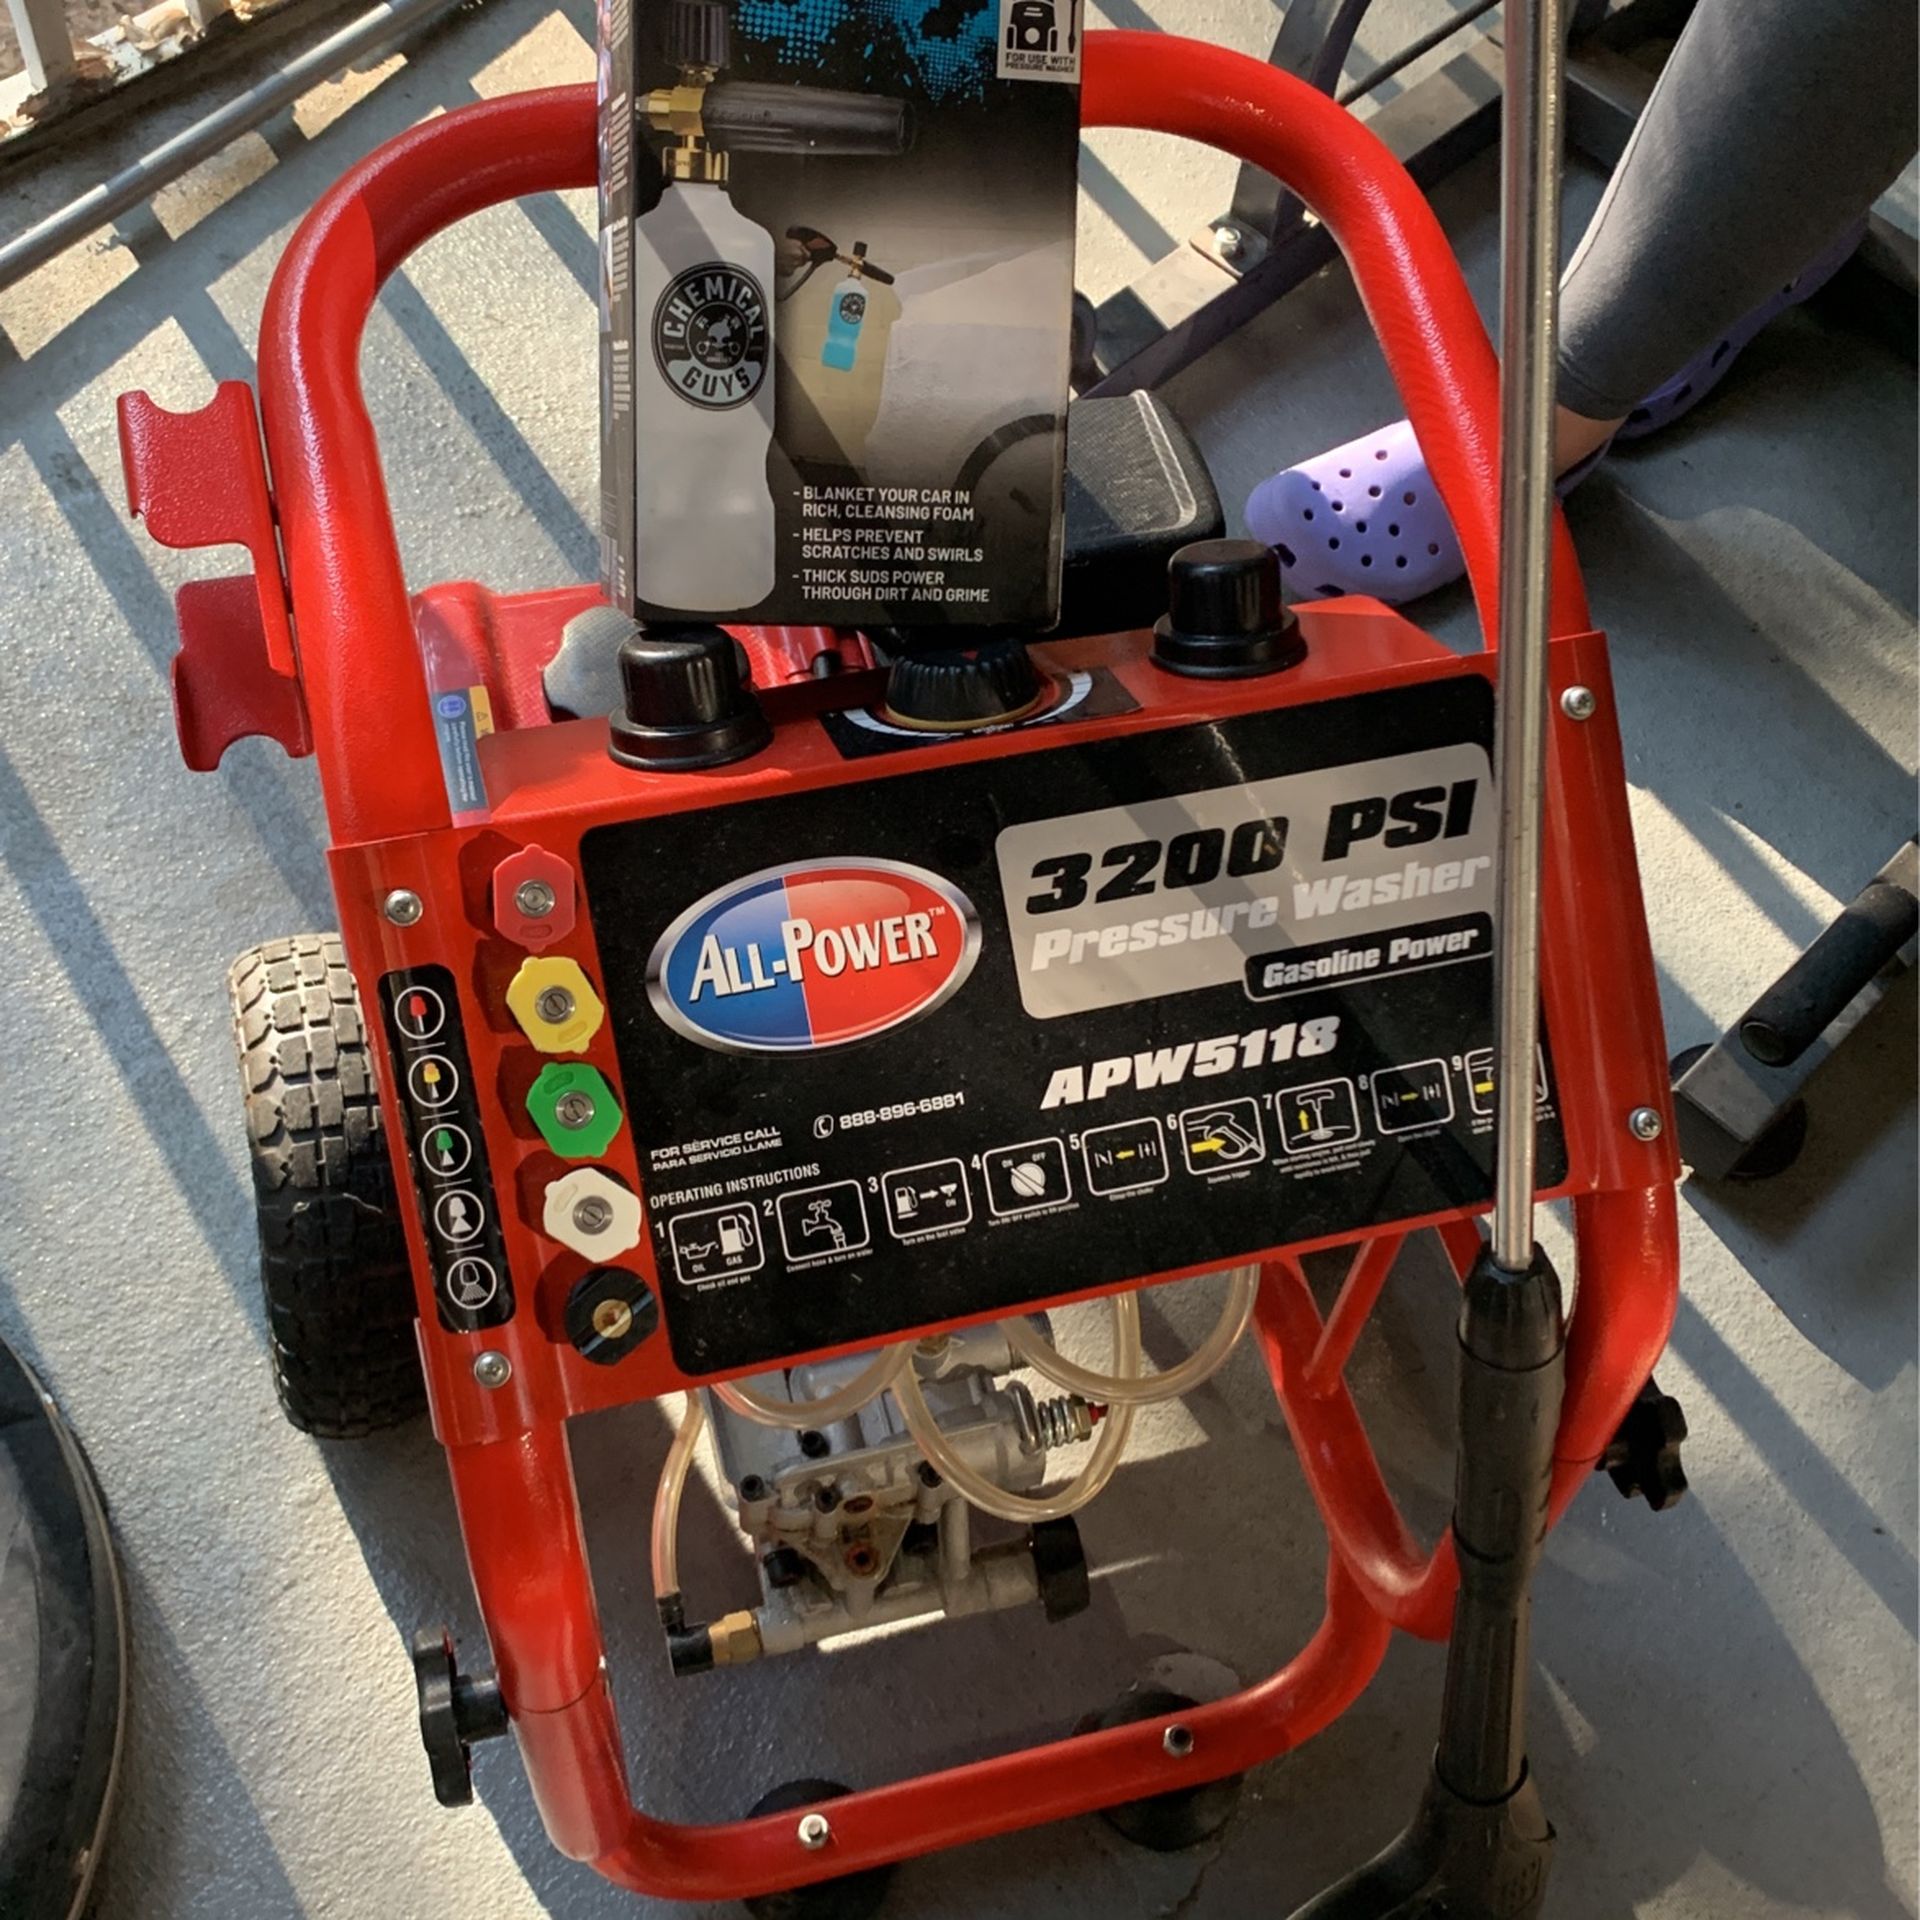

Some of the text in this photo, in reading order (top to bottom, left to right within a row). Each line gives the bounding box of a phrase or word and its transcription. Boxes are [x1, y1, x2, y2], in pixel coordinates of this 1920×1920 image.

[1006, 52, 1076, 65] FOR USE WITH
[663, 276, 763, 339] CHEMICAL
[682, 366, 750, 397] GUYS
[803, 486, 874, 501] BLANKET
[878, 488, 918, 502] YOUR
[921, 489, 952, 503] CAR
[955, 490, 970, 504] IN
[803, 504, 974, 521] RICH, CLEANSING FOAM
[803, 528, 852, 542] HELPS
[855, 530, 924, 544] PREVENT
[802, 545, 984, 562] SCRATCHES AND SWIRLS
[803, 569, 847, 583] THICK
[850, 570, 889, 584] SUDS
[892, 570, 944, 585] POWER
[802, 586, 989, 602] THROUGH DIRT AND GRIME
[1026, 778, 1478, 915] 3200 PSI
[1030, 855, 1491, 971] Pressure Washer
[1263, 927, 1479, 988] Gasoline Power
[1040, 1016, 1340, 1110] APW5118
[1451, 1056, 1462, 1071] 9
[1358, 1074, 1368, 1090] 8
[840, 1092, 965, 1129] 888-896-6881
[1263, 1094, 1272, 1110] 7
[1166, 1114, 1177, 1130] 6
[651, 1126, 781, 1160] FOR SERVICE CALL
[1069, 1134, 1080, 1150] 5
[653, 1138, 783, 1172] PARA SERVICIO LLAME
[971, 1154, 982, 1170] 4
[1032, 1152, 1046, 1162] OFF
[650, 1163, 820, 1209] OPERATING INSTRUCTIONS
[867, 1176, 878, 1193] 3
[763, 1199, 774, 1216] 2
[655, 1221, 665, 1238] 1
[692, 1263, 706, 1274] OIL
[726, 1255, 742, 1266] GAS
